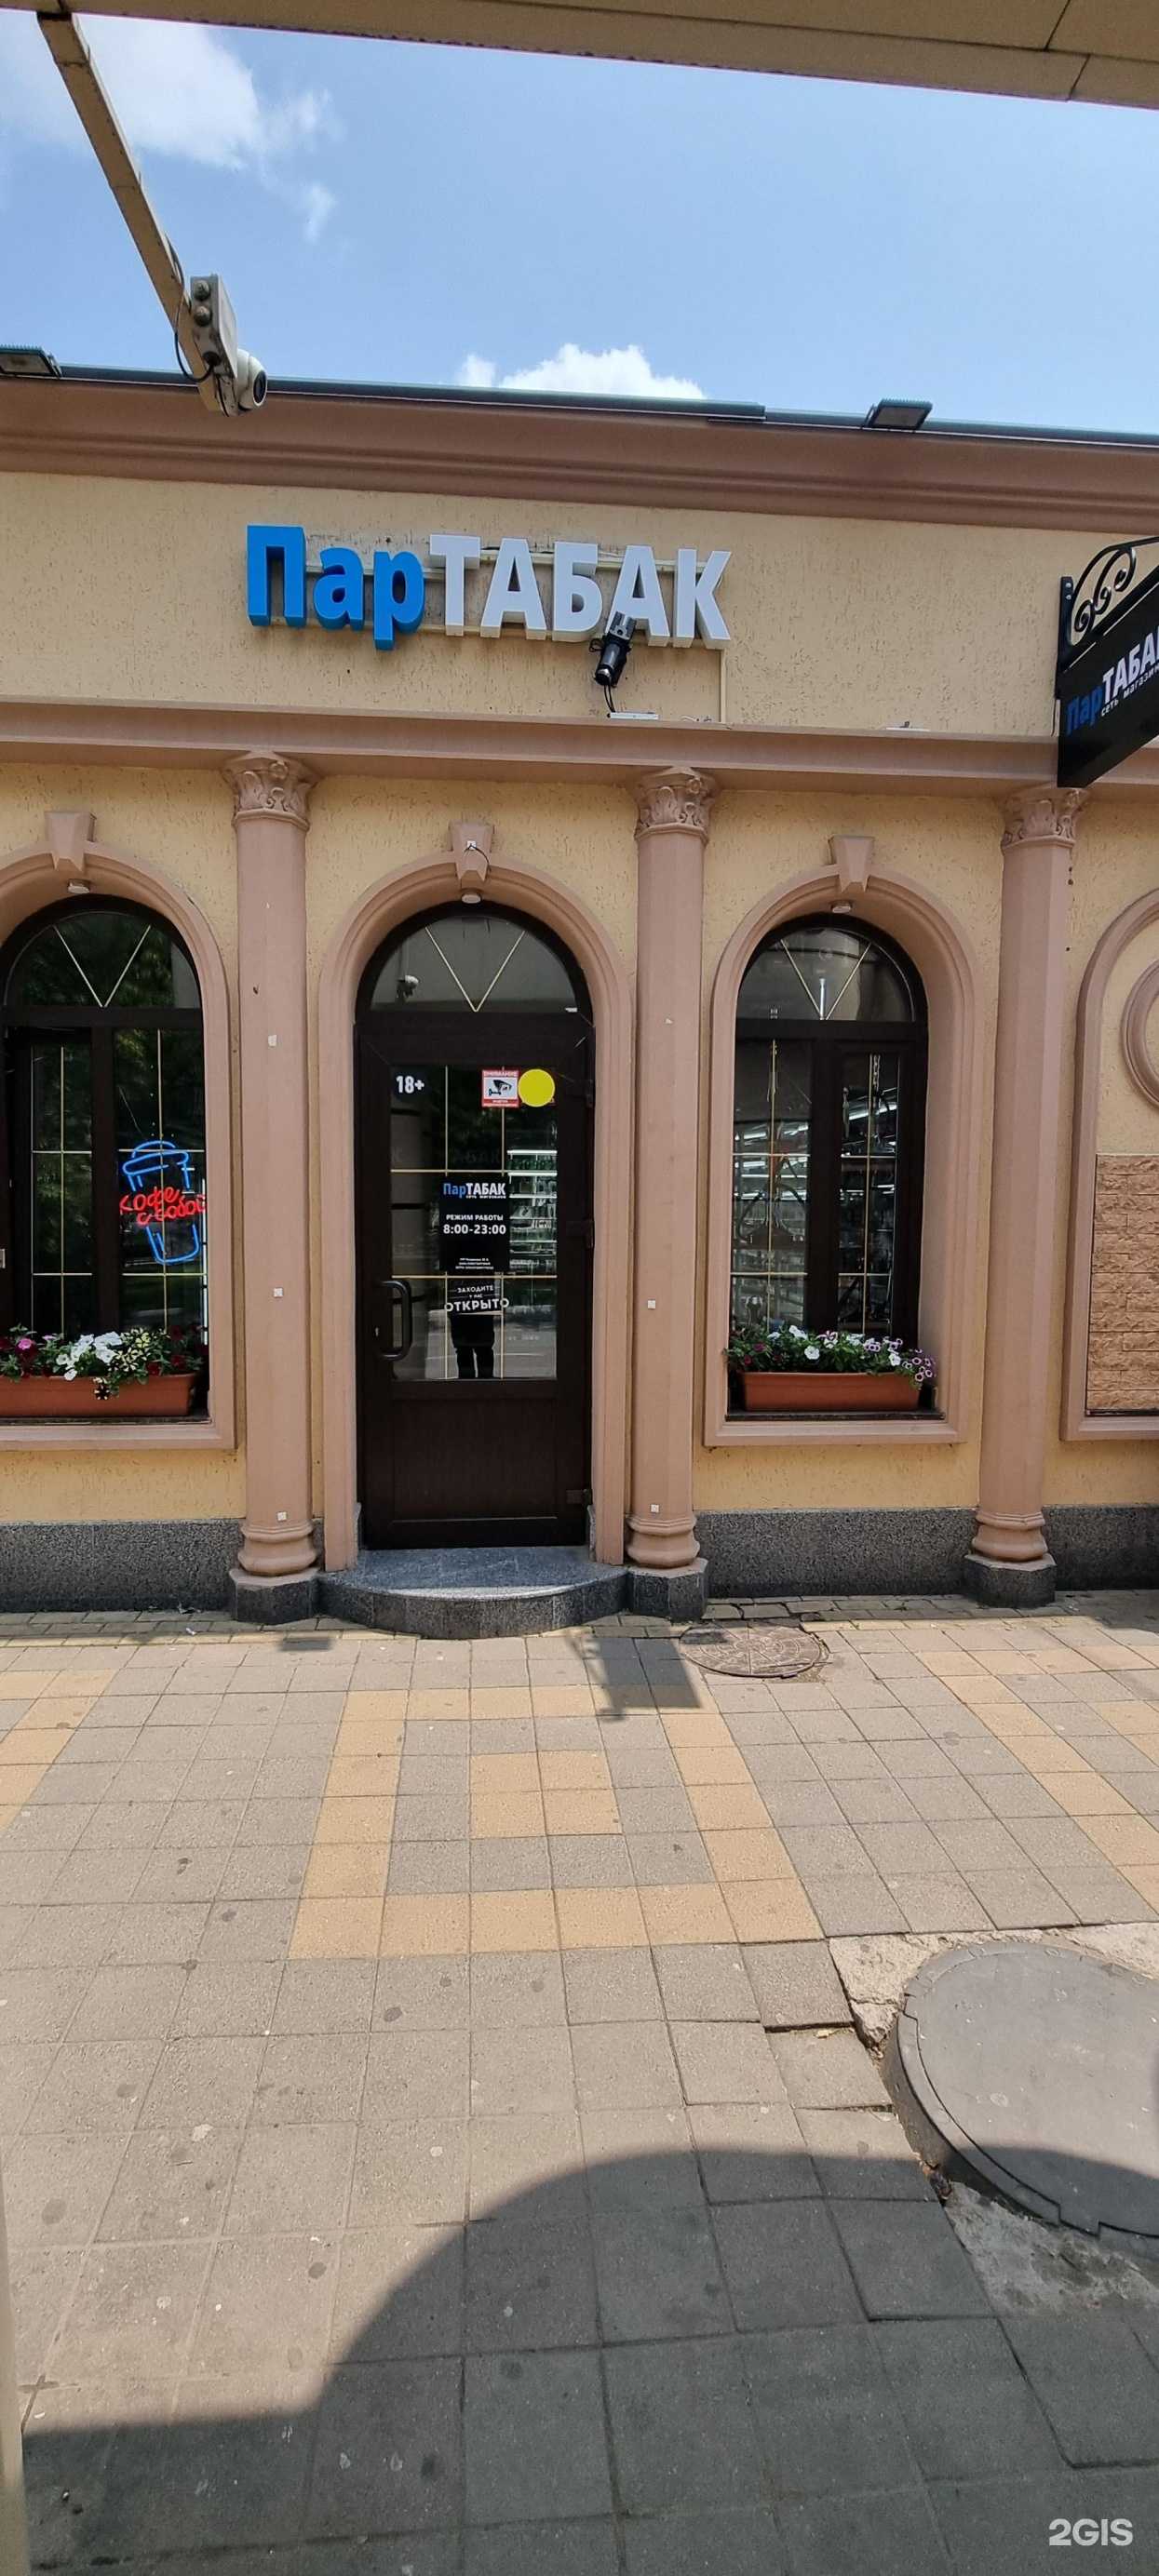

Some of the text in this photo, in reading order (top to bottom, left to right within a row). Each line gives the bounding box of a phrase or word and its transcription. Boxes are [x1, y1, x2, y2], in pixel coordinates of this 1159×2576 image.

[247, 524, 732, 651] ПарТАБАК
[1066, 625, 1159, 736] ПарТАБА
[396, 1075, 425, 1094] 18+
[443, 1182, 506, 1199] ПарТАБАК
[443, 1224, 506, 1235] 8:00-23:00
[457, 1284, 494, 1294] ЗАХОДИТЕ
[444, 1297, 510, 1312] ОТКРЫТО
